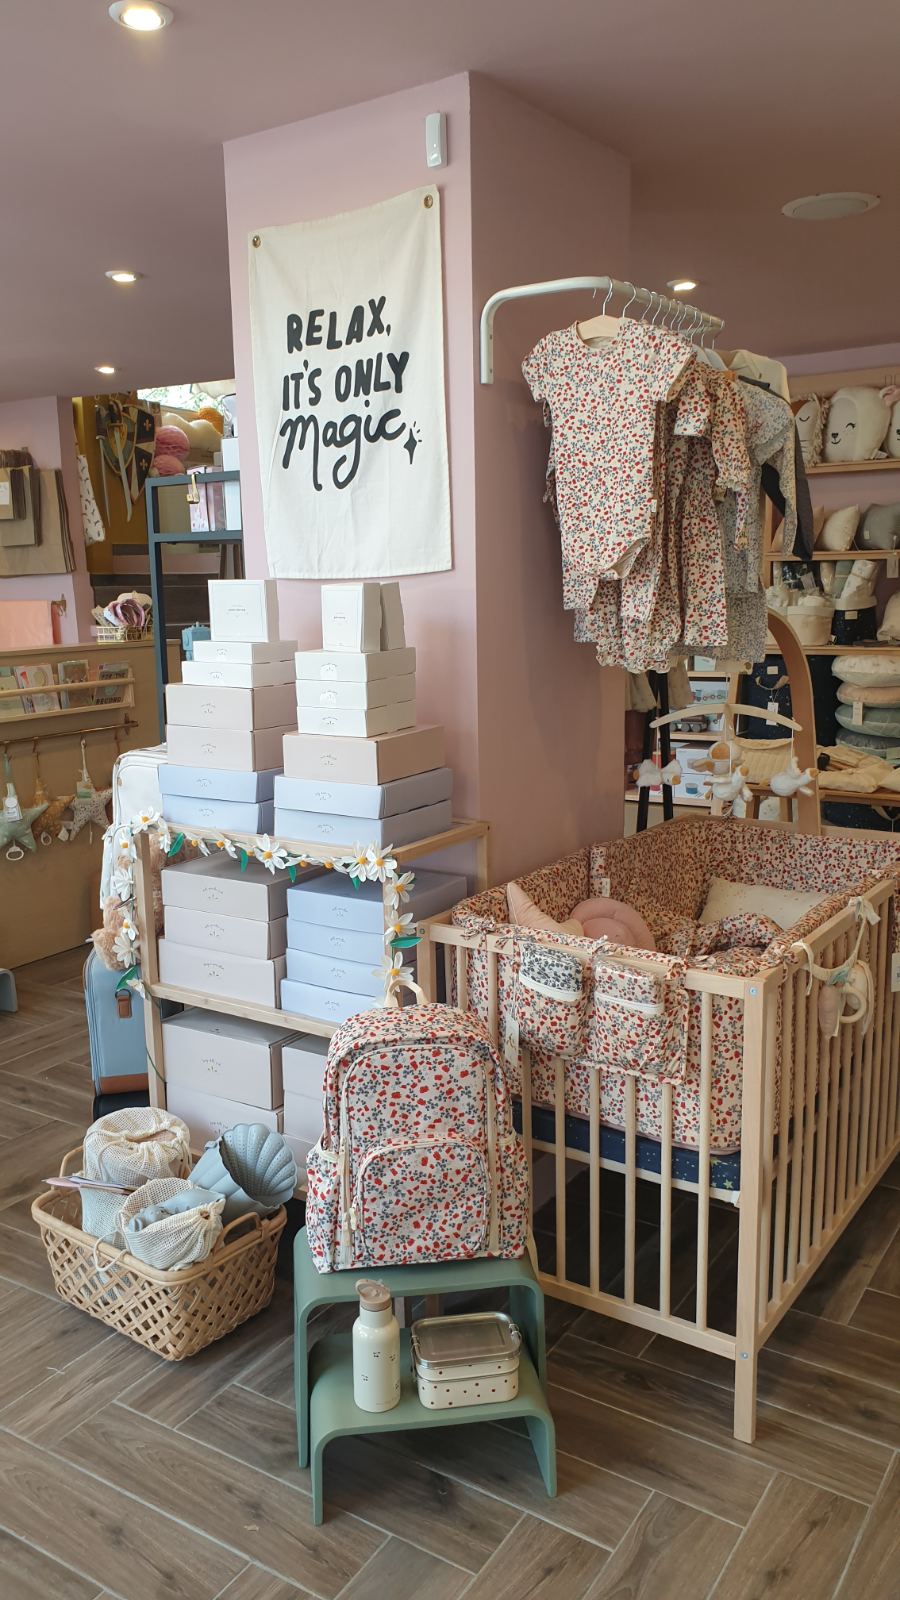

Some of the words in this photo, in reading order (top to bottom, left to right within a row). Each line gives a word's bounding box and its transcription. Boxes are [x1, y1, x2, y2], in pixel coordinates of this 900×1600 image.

[286, 295, 391, 354] RELAX,
[282, 359, 322, 412] IT'S
[334, 351, 410, 403] ONLY
